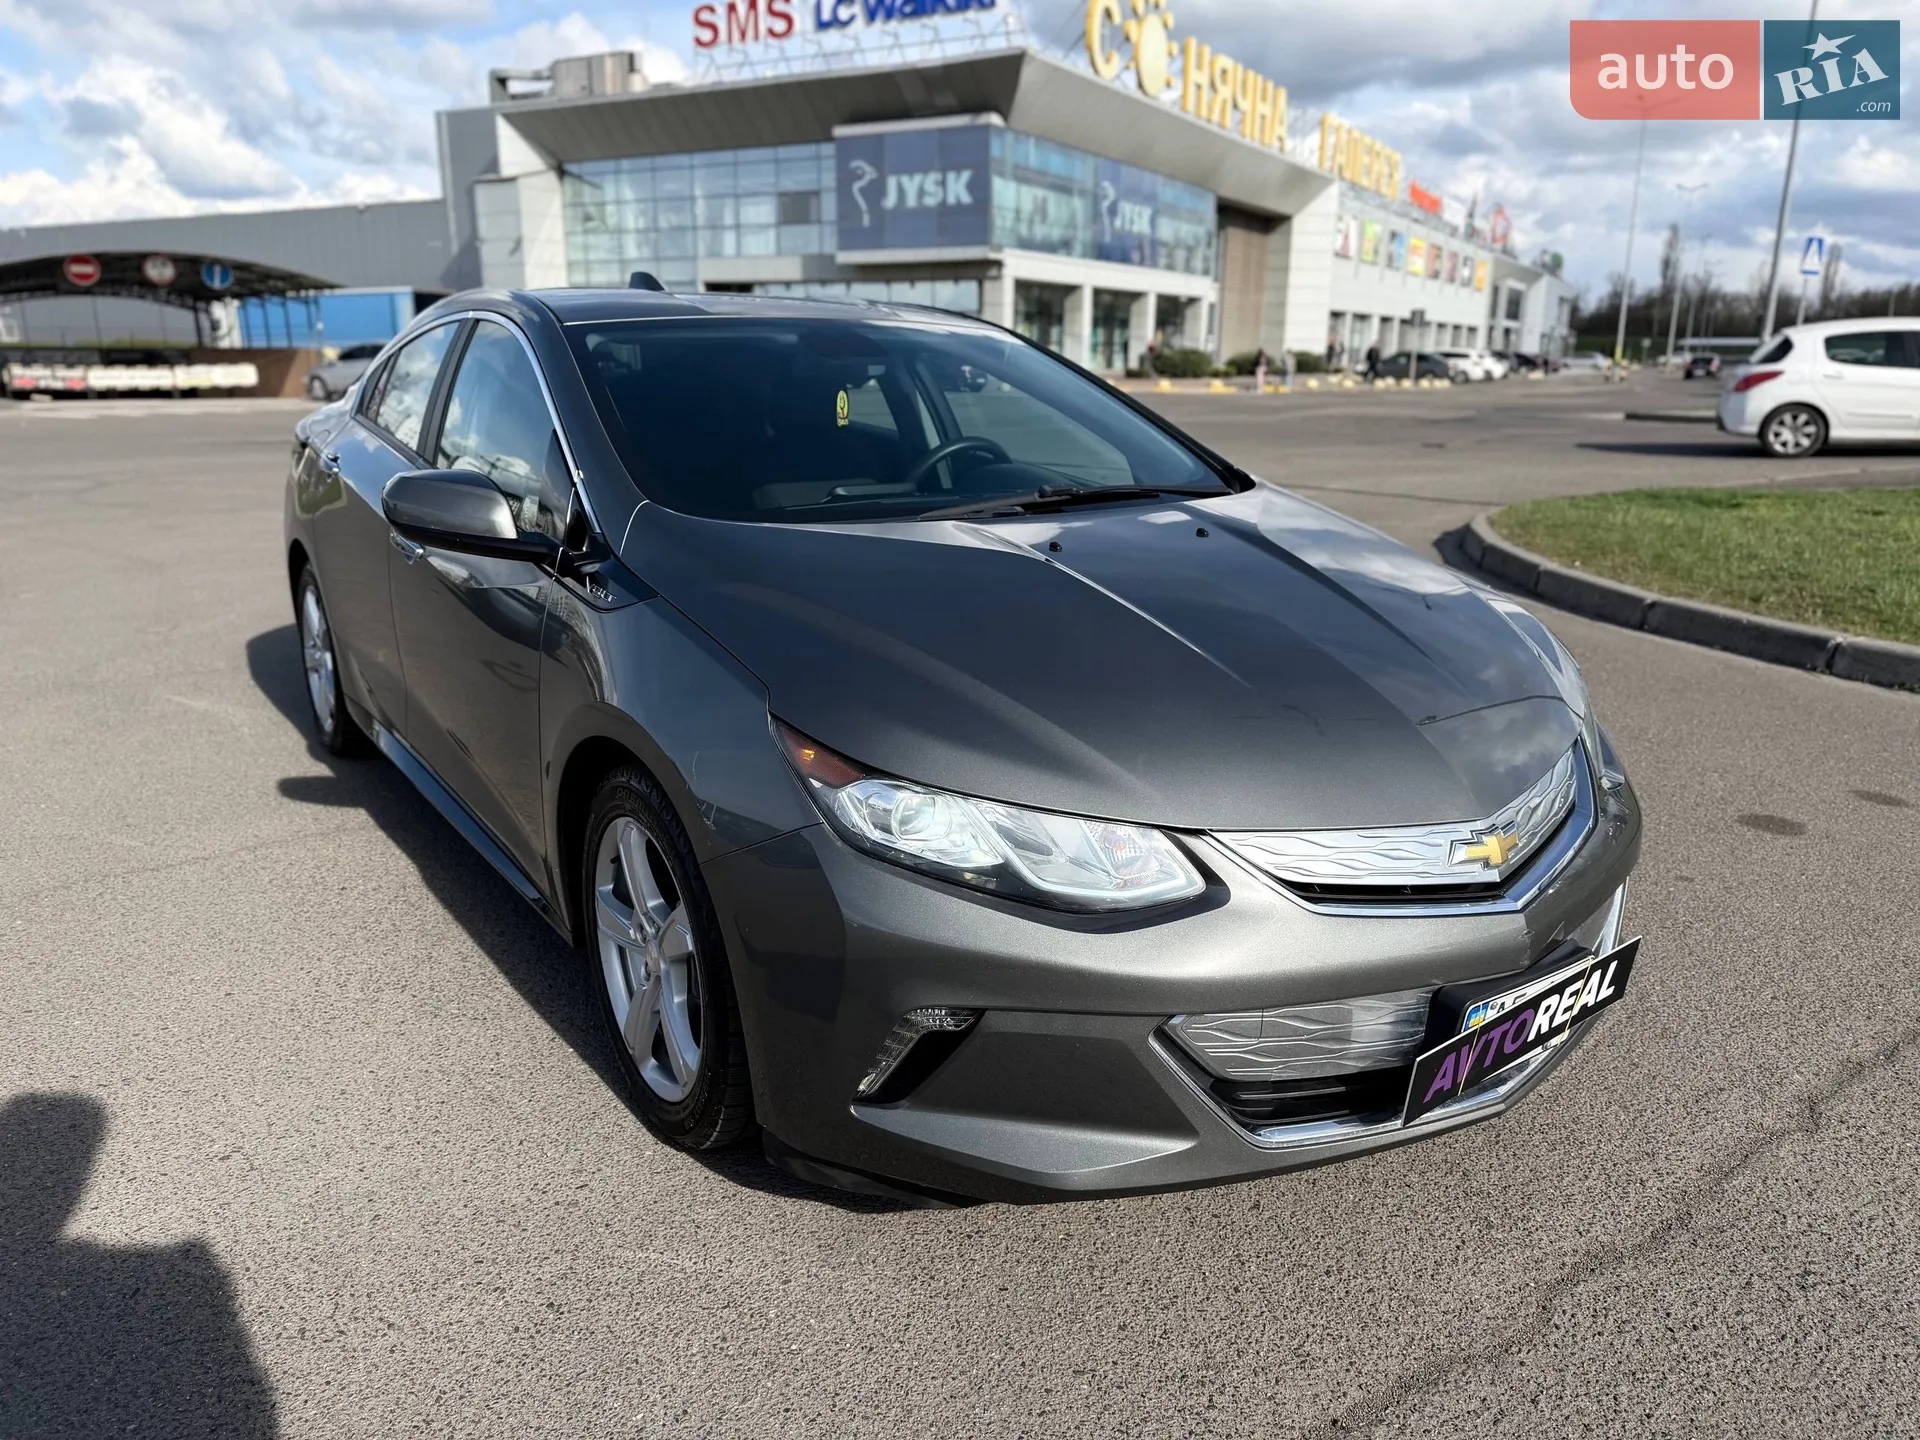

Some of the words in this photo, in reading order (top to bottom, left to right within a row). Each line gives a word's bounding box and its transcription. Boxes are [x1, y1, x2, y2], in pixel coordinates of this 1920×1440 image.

[692, 0, 795, 48] SMS
[881, 168, 974, 210] JYSK
[1113, 199, 1153, 236] JYSK
[1422, 959, 1619, 1104] AVTOREAL
